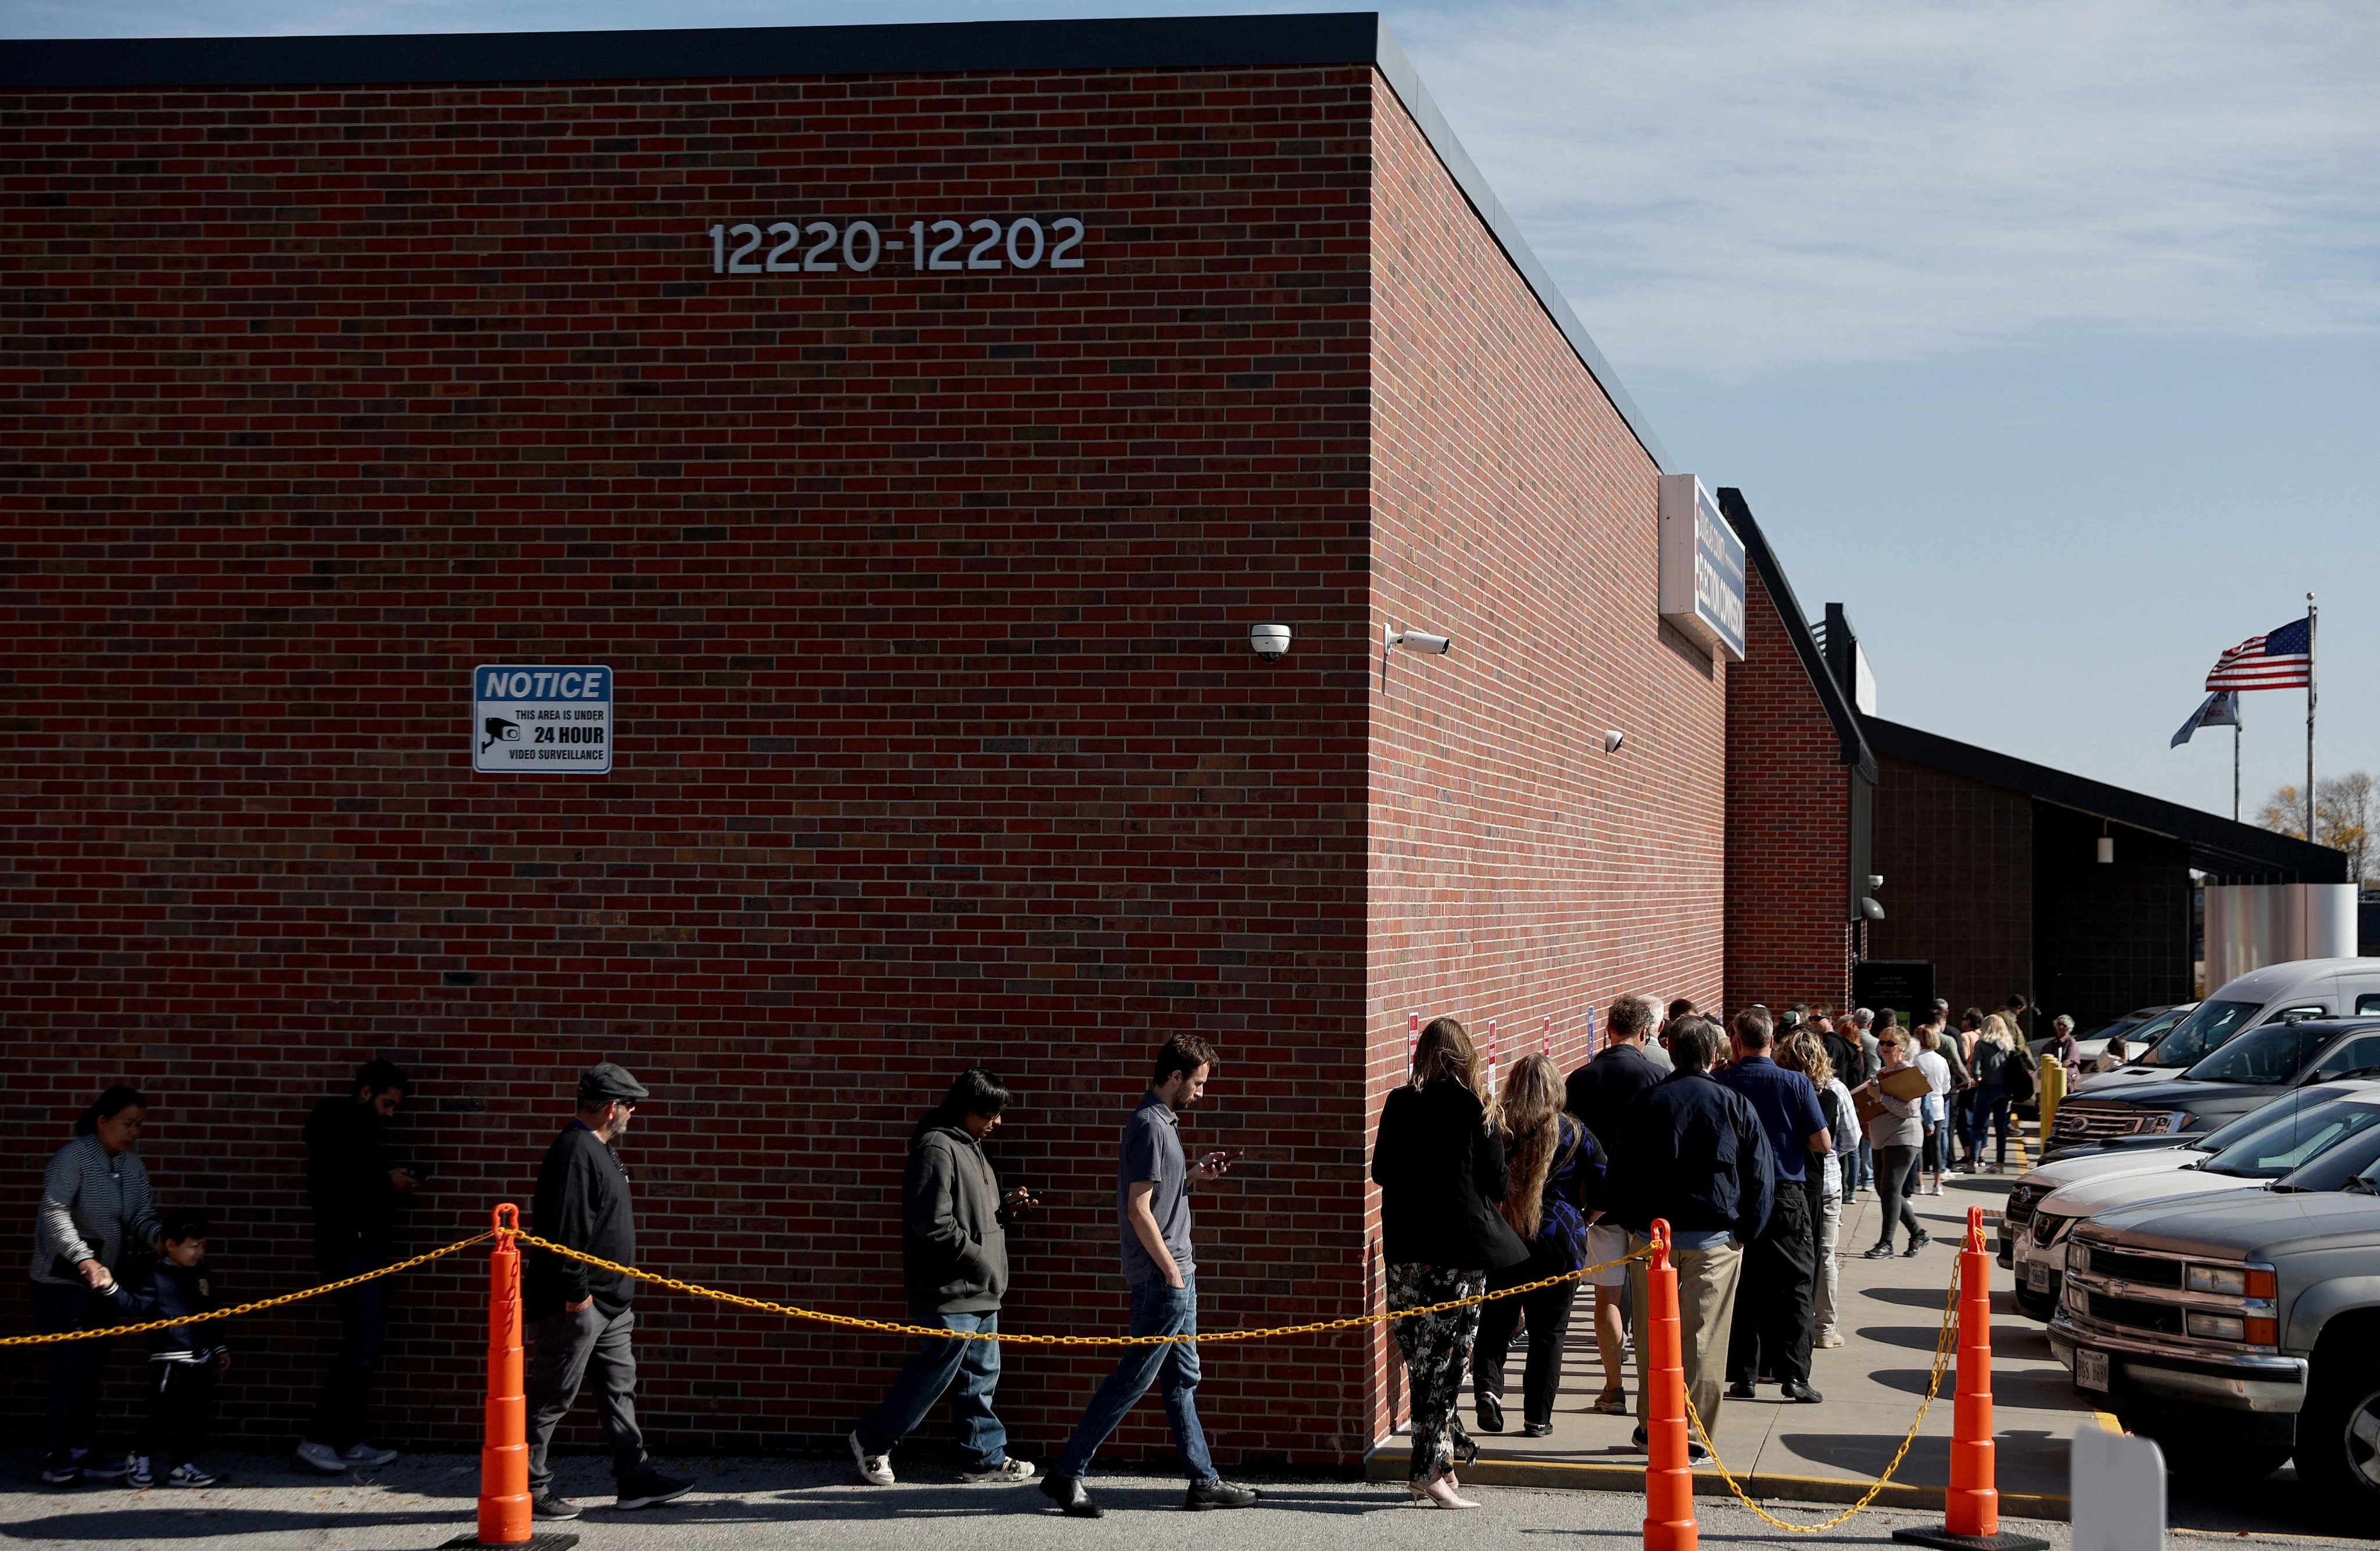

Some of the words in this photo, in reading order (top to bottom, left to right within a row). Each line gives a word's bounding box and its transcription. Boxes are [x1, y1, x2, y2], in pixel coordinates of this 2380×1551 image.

[709, 217, 1085, 274] 12220-12202
[1699, 551, 1720, 618] ELECTION
[485, 672, 602, 698] NOTICE
[516, 710, 535, 720] THIS
[538, 710, 560, 720] AREA
[563, 710, 571, 720] IS
[574, 710, 604, 720] UNDER
[534, 726, 555, 744] 24
[559, 726, 604, 744] HOUR
[509, 749, 535, 760] VIDEO
[538, 749, 604, 760] SURVEILLANCE
